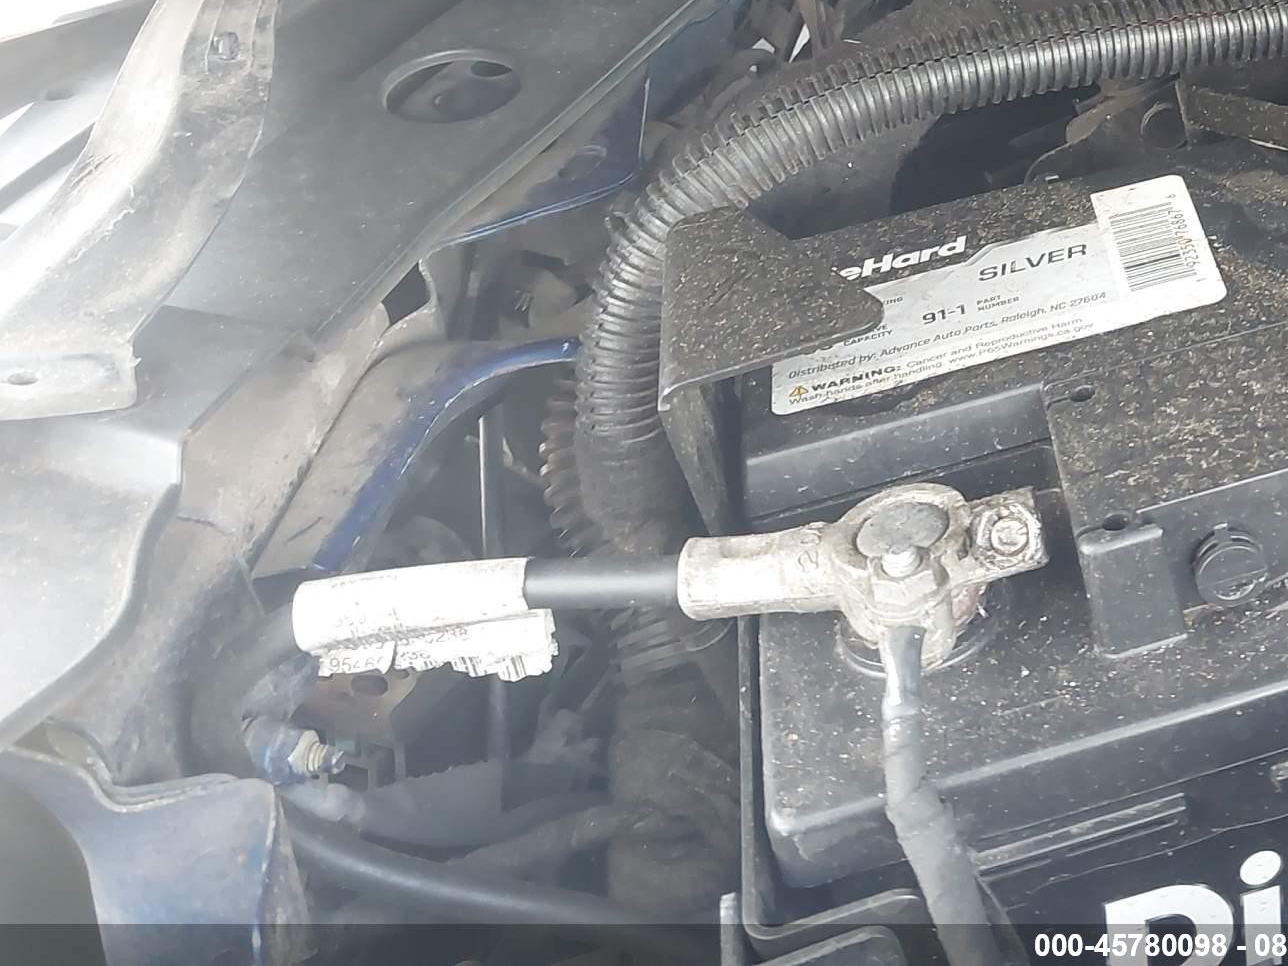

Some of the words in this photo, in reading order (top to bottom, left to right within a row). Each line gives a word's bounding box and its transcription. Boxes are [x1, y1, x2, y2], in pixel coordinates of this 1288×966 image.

[833, 236, 966, 280] eHard
[979, 244, 1087, 281] SILVER
[976, 294, 1001, 306] PART
[977, 296, 1019, 311] NUMBER
[922, 304, 965, 325] 91-1
[788, 355, 856, 379] Distributed
[858, 352, 876, 365] by:
[879, 338, 931, 357] Advance
[932, 329, 962, 343] Auto
[964, 321, 998, 334] Parts,
[1001, 308, 1047, 324] Raleigh,
[1050, 301, 1066, 312] NC
[1070, 291, 1106, 308] 27604
[843, 329, 893, 347] CAPACITY
[811, 366, 901, 391] WARNING:
[906, 352, 947, 368] Cancer
[950, 345, 972, 356] and
[975, 326, 1048, 349] Reproductive
[1051, 318, 1082, 329] Harm
[789, 393, 823, 405] Wash
[825, 384, 863, 398] hands
